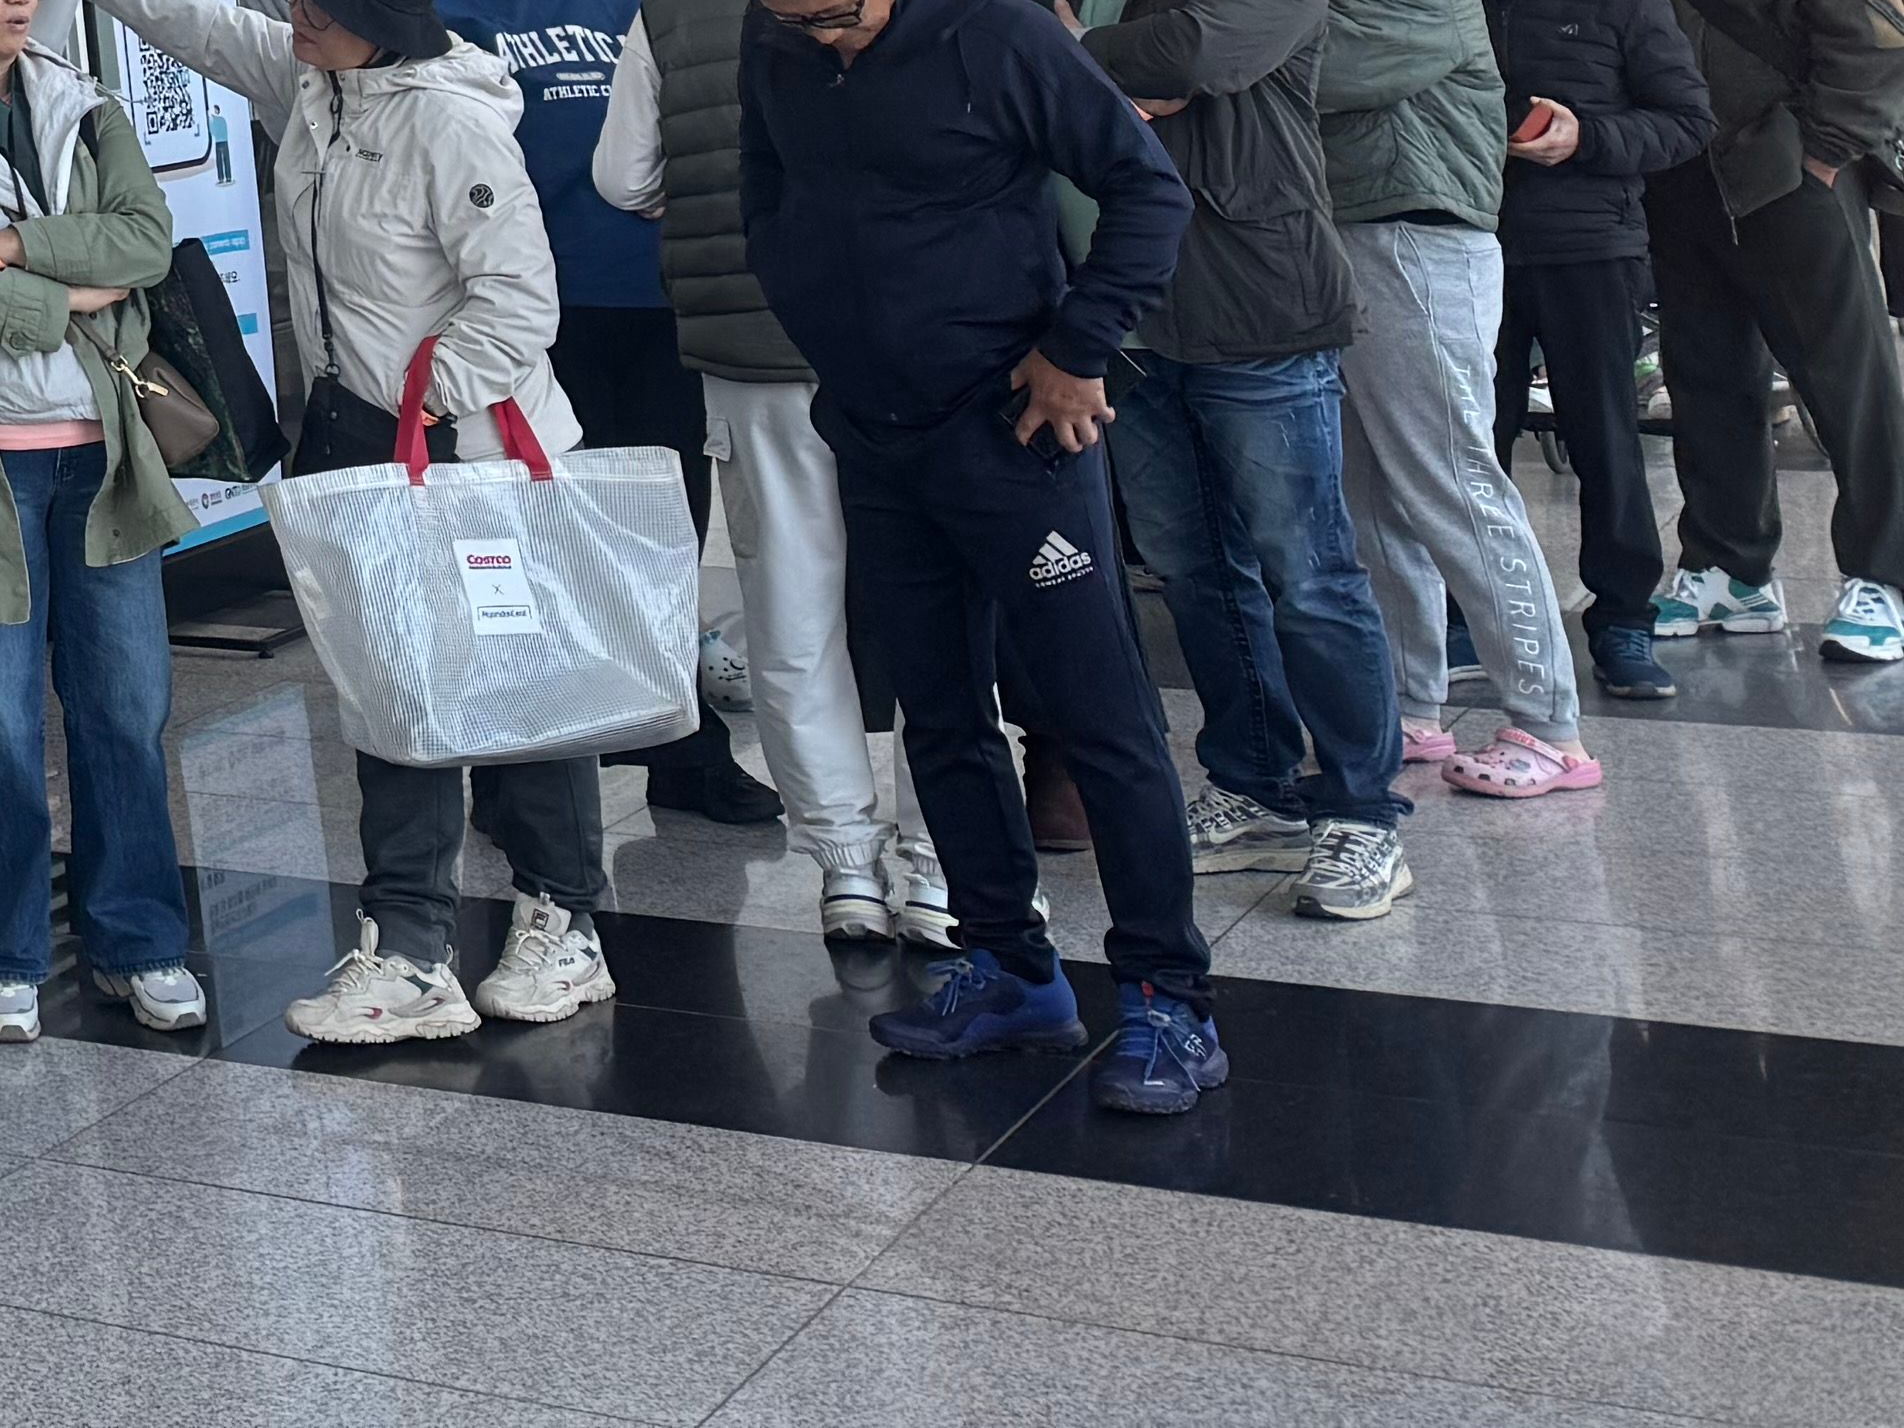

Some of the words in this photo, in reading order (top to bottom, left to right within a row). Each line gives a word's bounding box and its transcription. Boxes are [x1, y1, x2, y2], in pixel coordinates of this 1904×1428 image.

[495, 24, 627, 74] ATHLETIC
[543, 84, 600, 101] ATHLETIC
[1467, 445, 1515, 538] THREE
[1029, 551, 1091, 580] adidas
[1500, 556, 1546, 696] STRIPES
